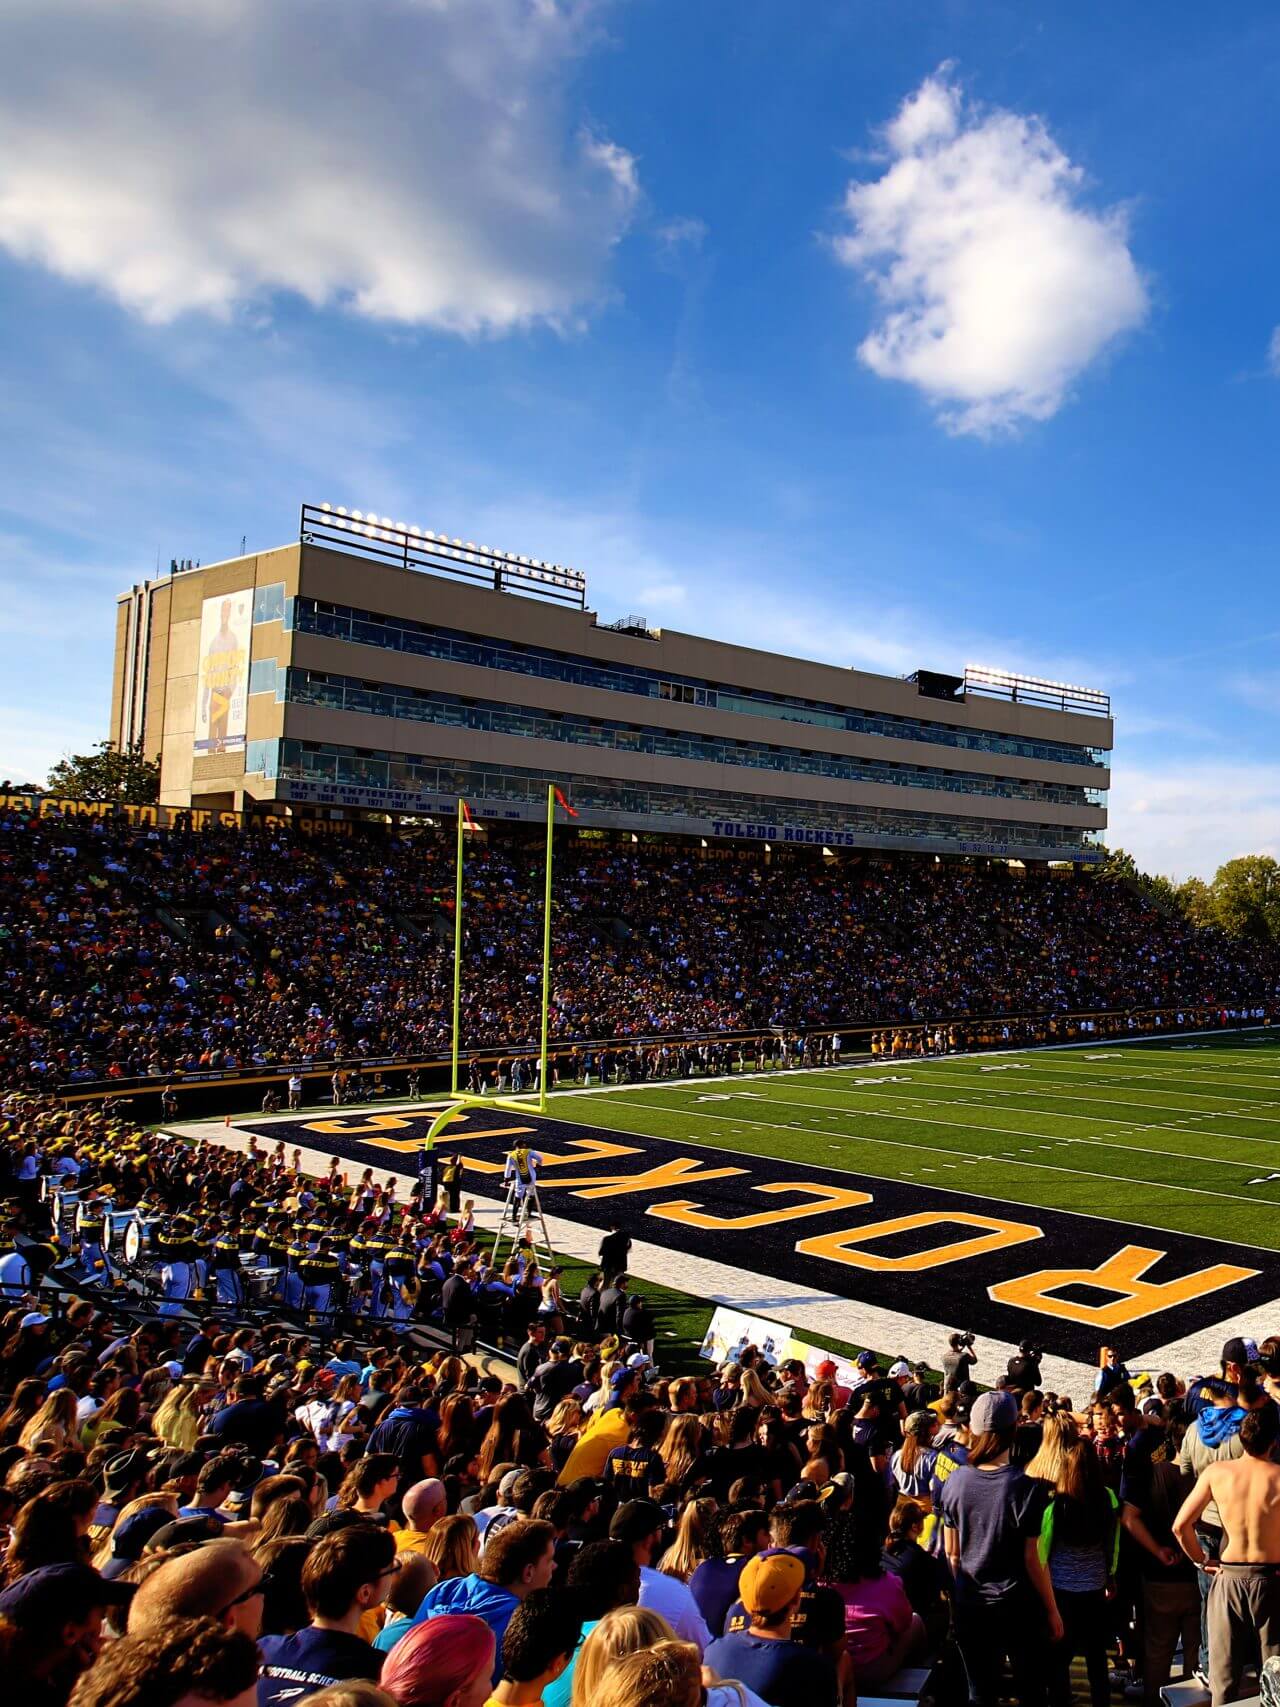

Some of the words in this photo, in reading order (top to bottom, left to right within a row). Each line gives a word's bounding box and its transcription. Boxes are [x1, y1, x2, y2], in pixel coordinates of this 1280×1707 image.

[290, 782, 317, 792] MAC
[323, 785, 422, 801] CHAMPIONSHIPS
[124, 804, 157, 826] TO
[712, 821, 777, 840] TOLEDO
[784, 828, 854, 845] ROCKETS
[300, 1110, 1263, 1330] ROCKETS
[267, 1666, 307, 1682] OOTBALL
